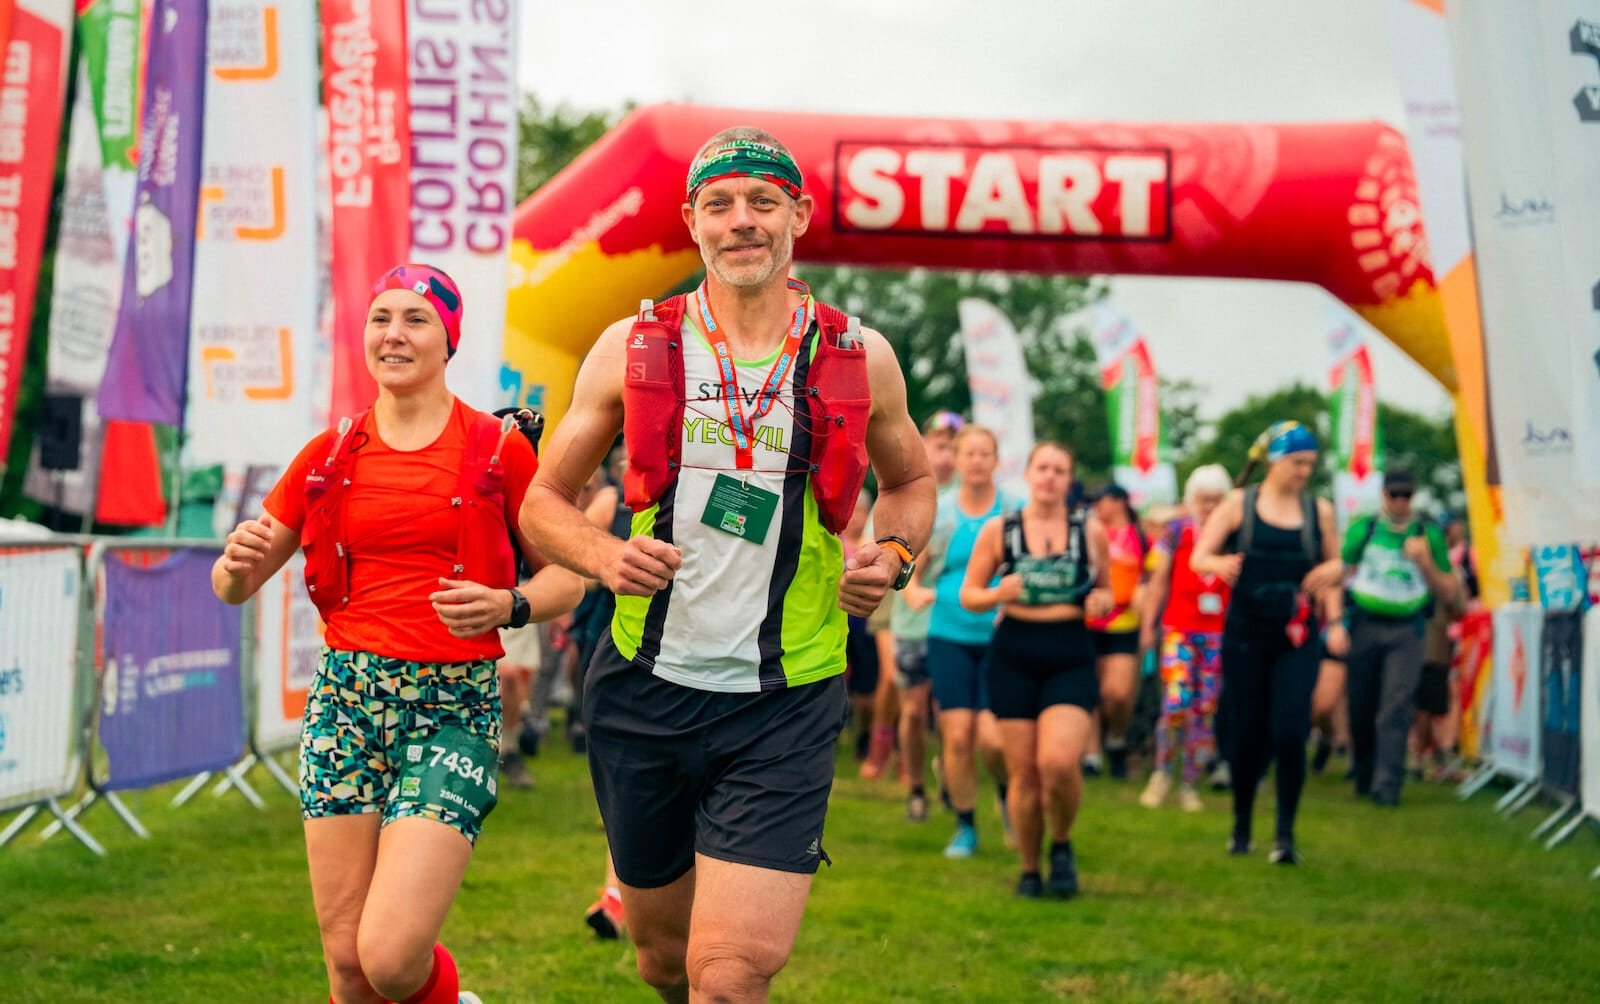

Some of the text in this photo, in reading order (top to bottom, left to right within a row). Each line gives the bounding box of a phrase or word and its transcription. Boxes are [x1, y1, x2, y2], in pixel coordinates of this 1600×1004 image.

[845, 147, 1167, 237] START
[698, 382, 765, 407] STV
[429, 745, 485, 786] 7434
[439, 789, 464, 806] 25KM
